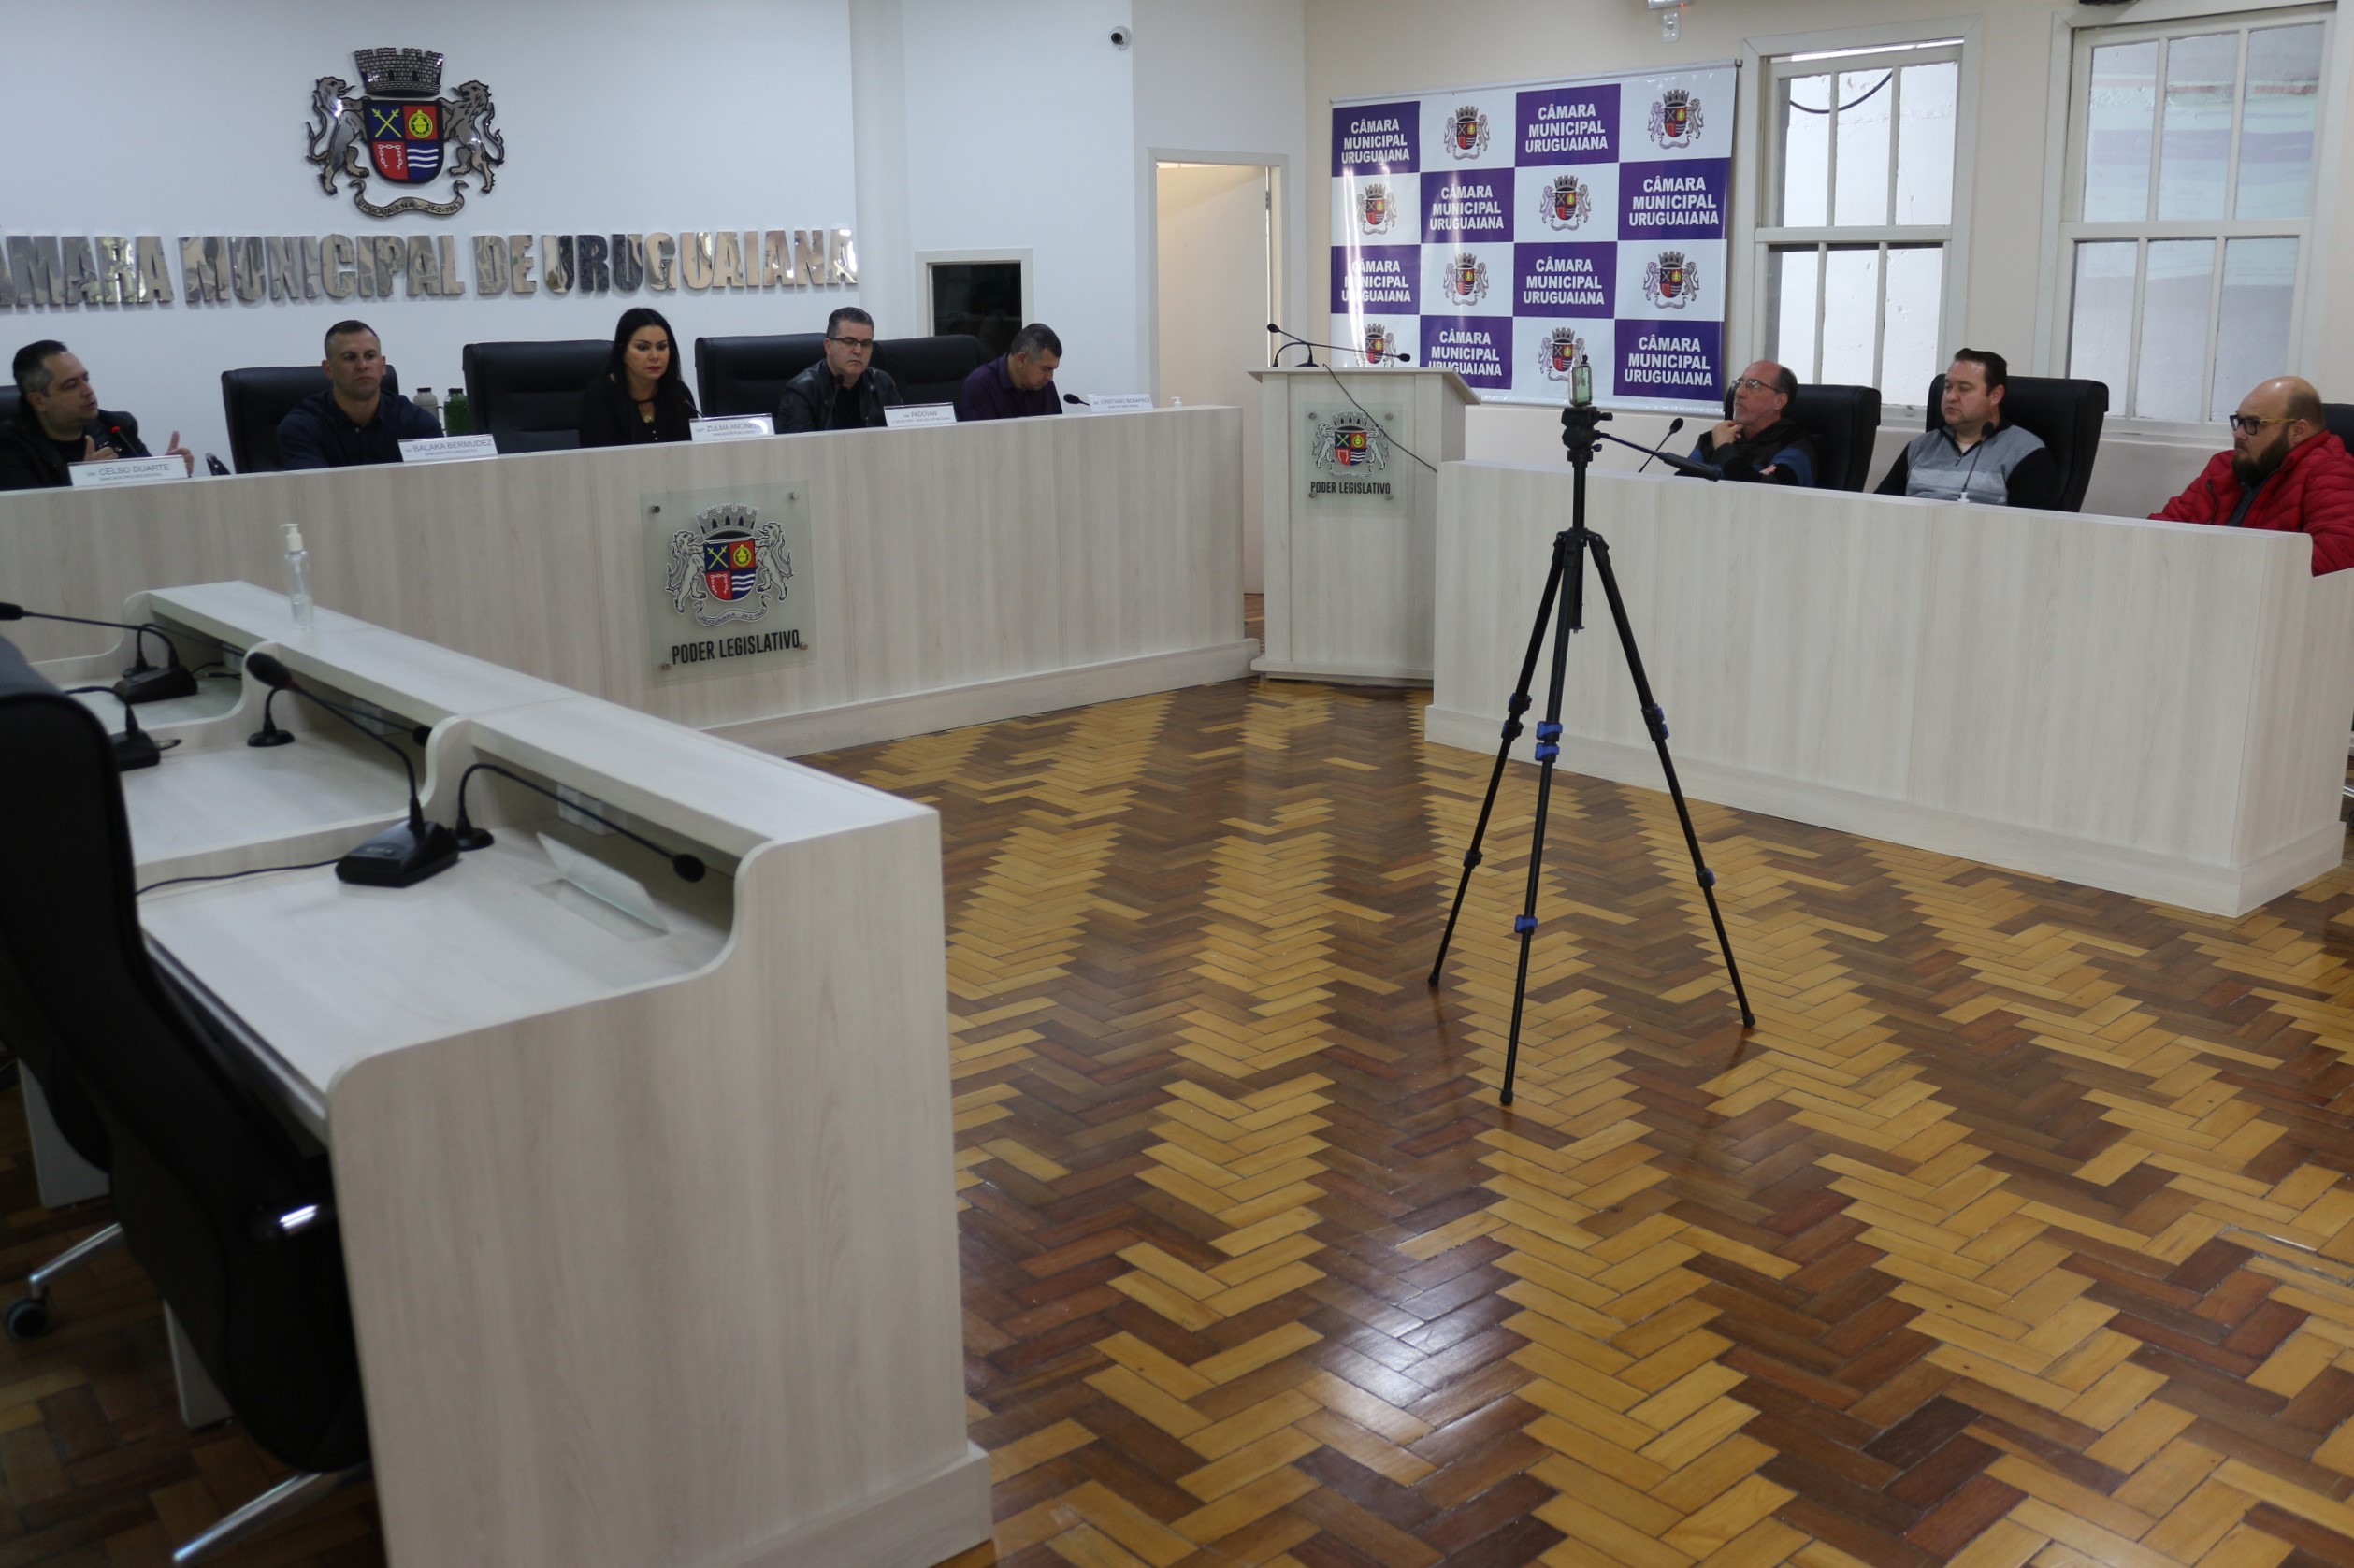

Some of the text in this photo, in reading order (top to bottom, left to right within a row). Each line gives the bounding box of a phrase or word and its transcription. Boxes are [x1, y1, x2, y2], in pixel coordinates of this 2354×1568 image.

[1538, 103, 1596, 121] CÂMARA
[1350, 118, 1399, 135] CÂMARA
[1528, 120, 1606, 137] MUNICIPAL
[1343, 134, 1408, 150] MUNICIPAL
[1525, 136, 1609, 153] URUGUAIANA
[1341, 148, 1410, 165] URUGUAIANA
[1440, 183, 1494, 199] CÂMARA
[1642, 175, 1706, 193] CÂMARA
[357, 198, 415, 216] URUGUAIANA
[1432, 201, 1502, 216] MUNICIPAL
[1633, 194, 1717, 210] MUNICIPAL
[1429, 216, 1504, 231] URUGUAIANA
[1628, 210, 1719, 226] URUGUAIANA
[178, 233, 466, 302] MUNICIPAL
[472, 234, 537, 295] DE
[542, 229, 859, 294] URUGUAIANA
[1536, 255, 1593, 272] CÂMARA
[1526, 275, 1603, 289] MUNICIPAL
[1341, 289, 1411, 302] UGUAIANA
[1523, 290, 1605, 305] URUGUAIANA
[1439, 328, 1492, 345] CÂMARA
[1639, 333, 1701, 352] CÂMARA
[1431, 346, 1500, 361] MUNICIPAL
[1627, 353, 1711, 370] MUNICIPAL
[1625, 368, 1713, 386] URUGUAIANA
[706, 424, 729, 432] ZULMA
[412, 443, 446, 453] BALAKA
[447, 439, 493, 449] BERMUDEZ
[98, 466, 131, 476] CELSO
[133, 463, 170, 473] DUARTE
[1311, 482, 1391, 495] PODER LEGISLATIVO
[672, 629, 801, 665] PODER LEGISLATIVO
